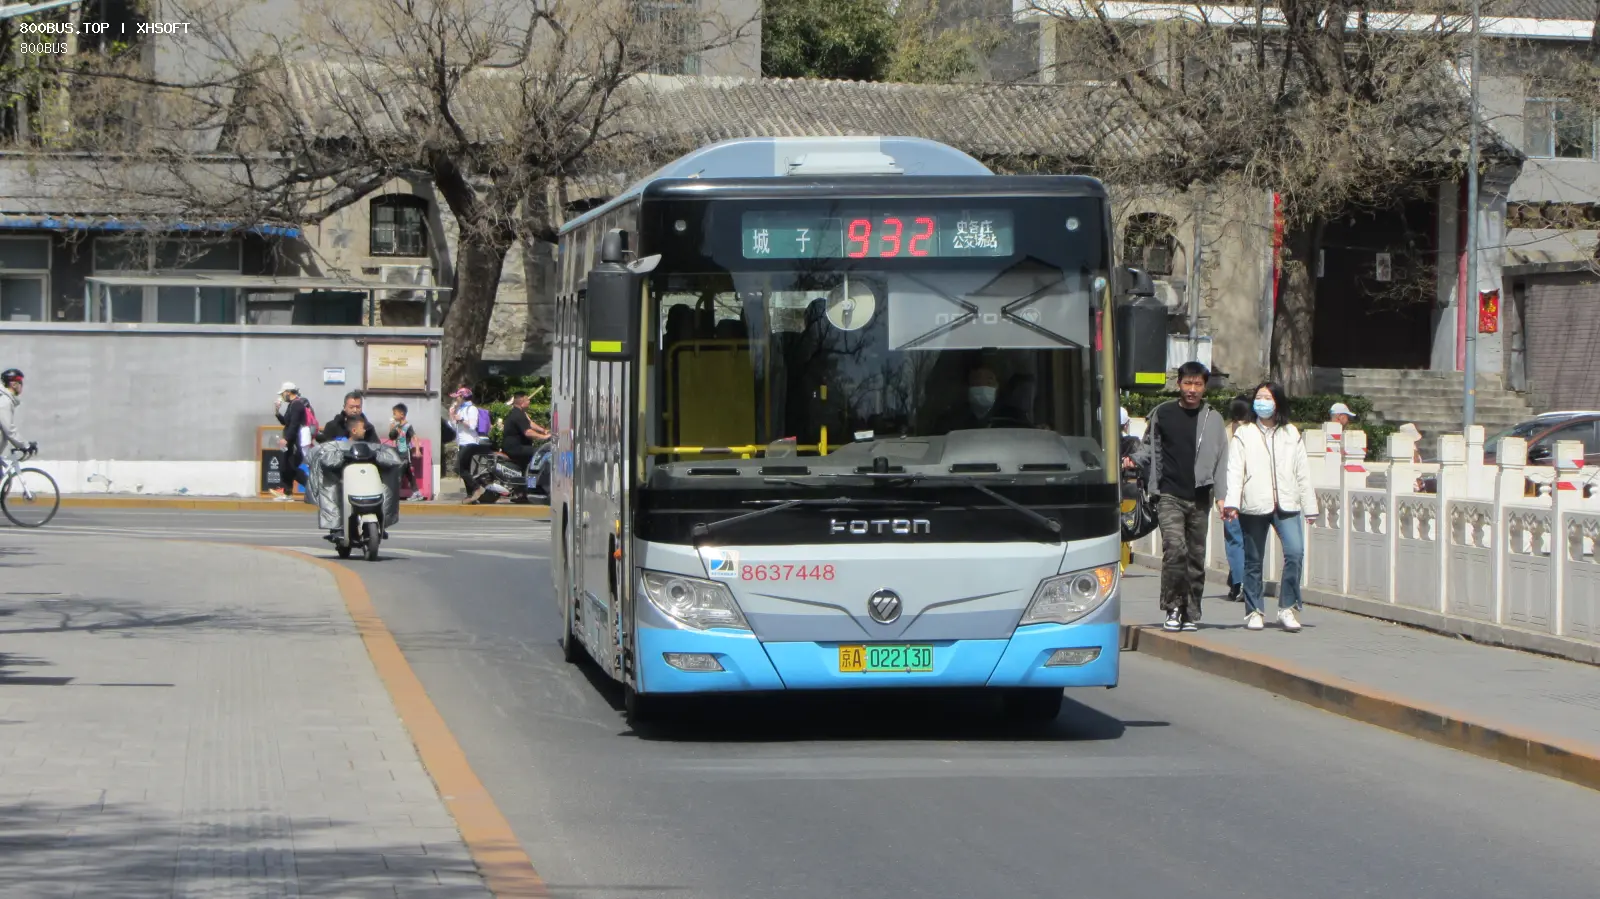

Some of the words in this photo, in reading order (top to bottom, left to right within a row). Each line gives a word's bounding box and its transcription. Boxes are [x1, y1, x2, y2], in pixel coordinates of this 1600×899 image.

[848, 217, 935, 258] 932
[829, 519, 931, 535] FOTON
[741, 564, 836, 581] 8637448
